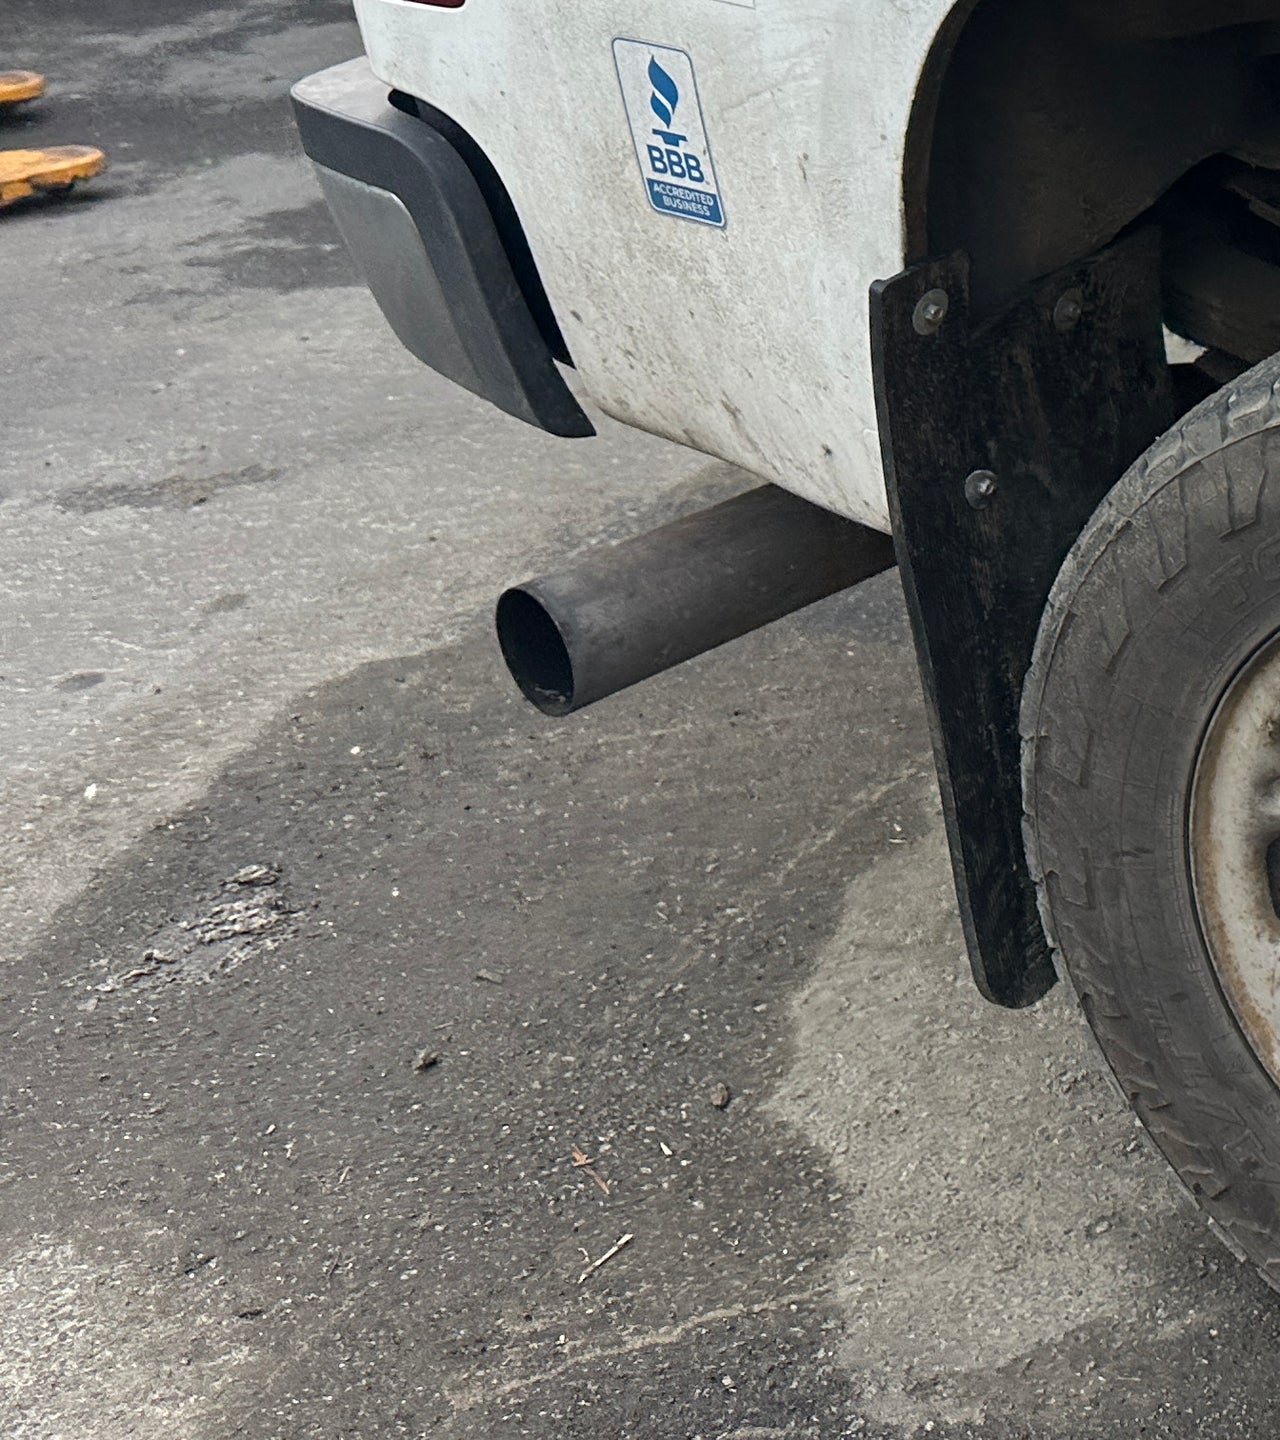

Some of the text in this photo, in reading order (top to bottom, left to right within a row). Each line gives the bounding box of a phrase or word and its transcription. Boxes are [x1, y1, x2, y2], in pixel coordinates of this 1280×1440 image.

[646, 143, 705, 183] BBB
[653, 182, 714, 206] ACCREDITED
[662, 195, 711, 217] BUSINESS
